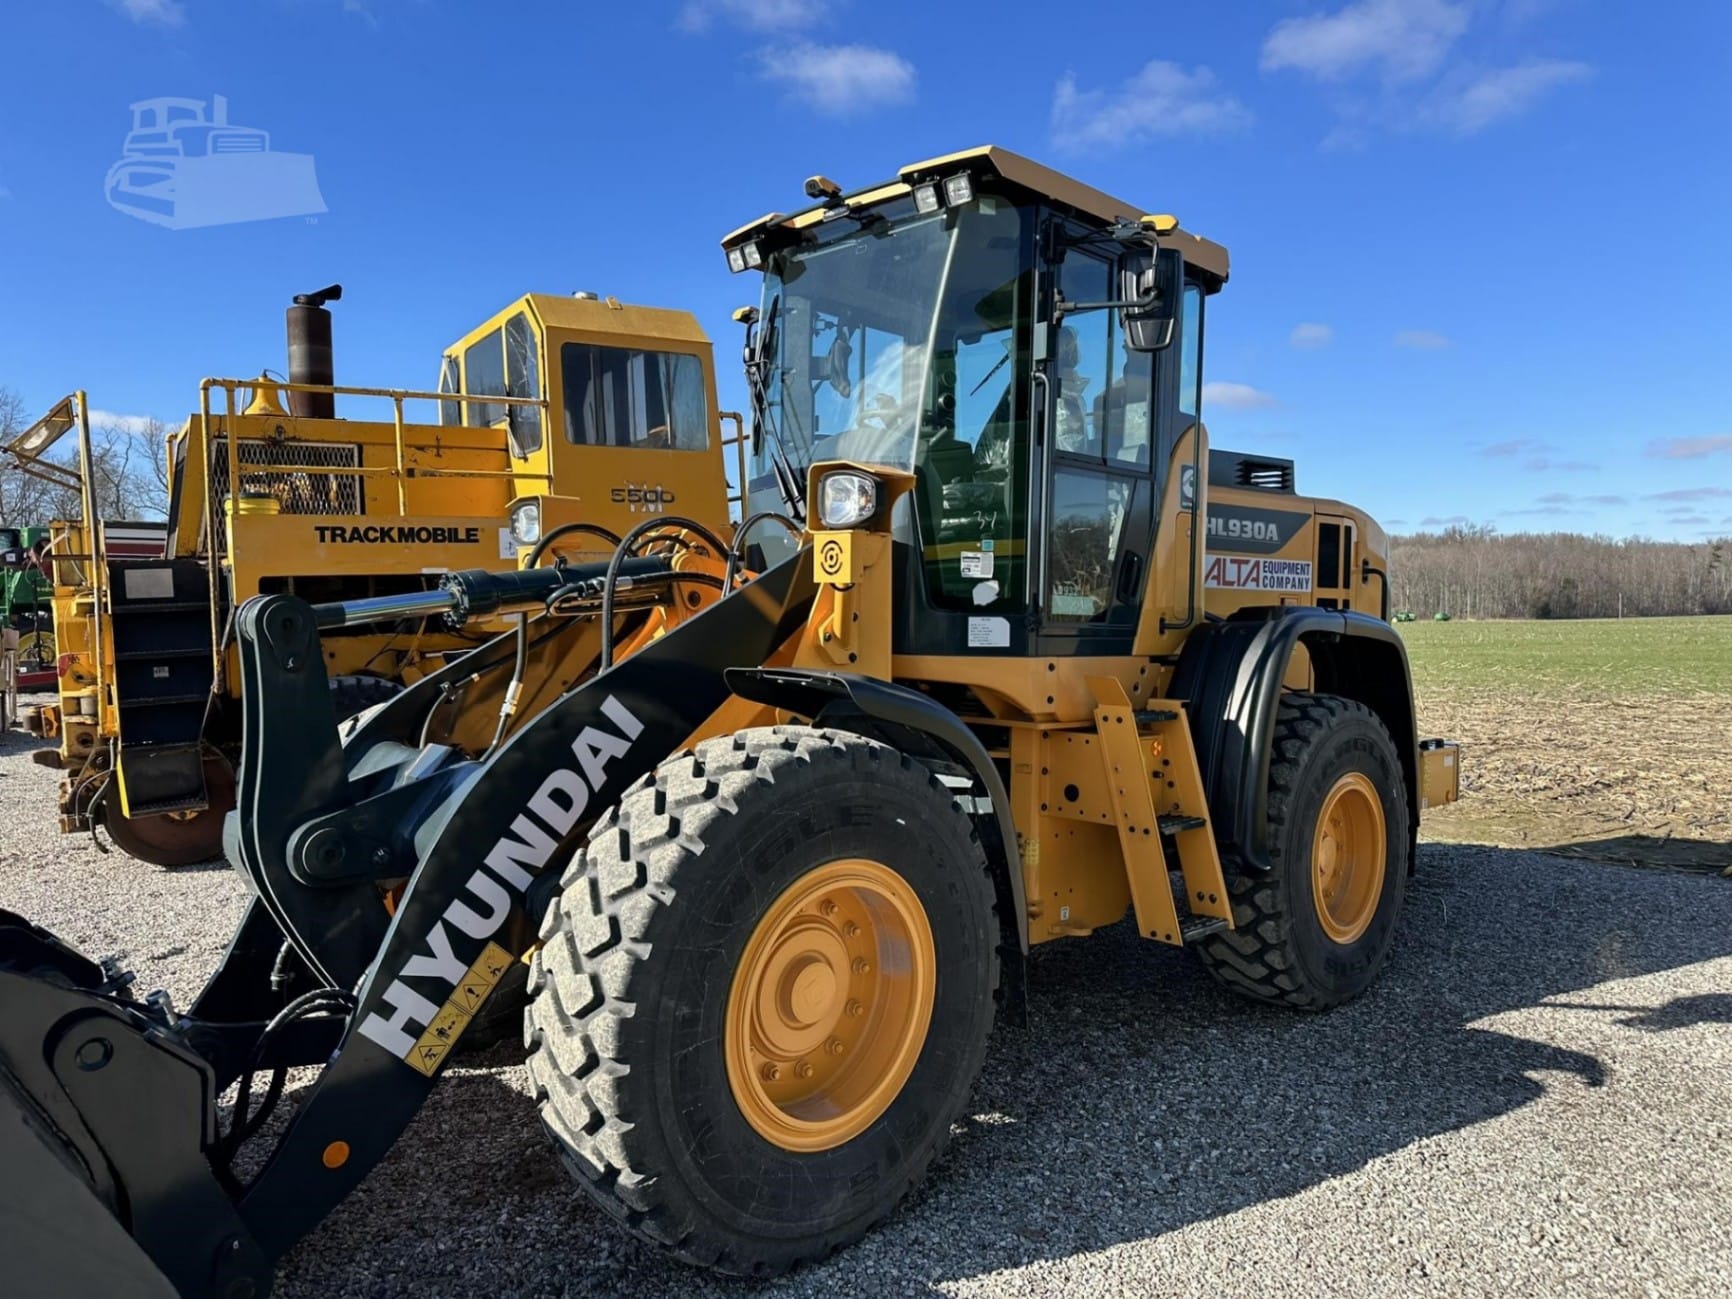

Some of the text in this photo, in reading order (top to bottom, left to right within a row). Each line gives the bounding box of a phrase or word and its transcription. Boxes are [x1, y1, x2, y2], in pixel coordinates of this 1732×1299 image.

[314, 526, 480, 543] TRACKMOBILE
[1206, 517, 1279, 541] HL930A
[1205, 557, 1260, 588] ALTA
[1262, 560, 1310, 575] EQUIPMENT
[1262, 574, 1309, 590] COMPANY
[358, 694, 645, 1062] HYUNDAI
